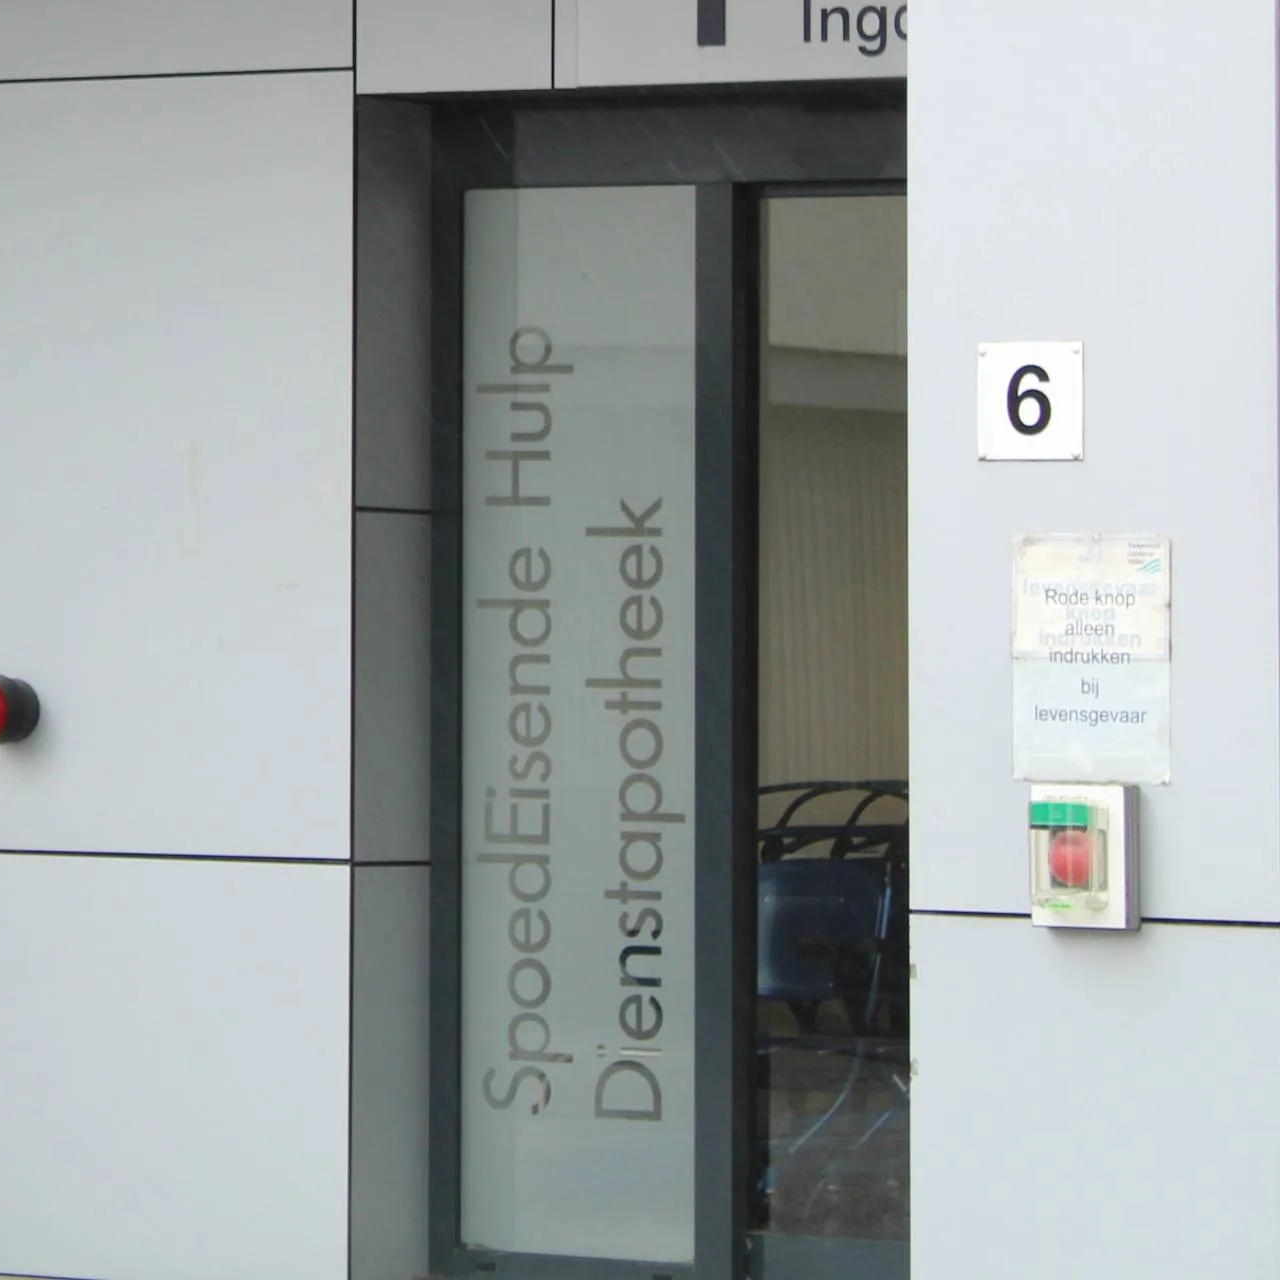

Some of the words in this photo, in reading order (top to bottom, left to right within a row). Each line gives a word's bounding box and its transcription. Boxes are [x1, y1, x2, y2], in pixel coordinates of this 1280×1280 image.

[1006, 363, 1052, 436] 6
[476, 325, 574, 507] Hulp
[1044, 588, 1089, 606] Rode
[1095, 589, 1136, 610] knop
[1064, 618, 1115, 637] alleen
[1049, 648, 1131, 665] indrukken
[1080, 677, 1100, 699] bij
[1034, 704, 1148, 727] levensgevaar
[585, 496, 686, 1122] Dienstapotheek
